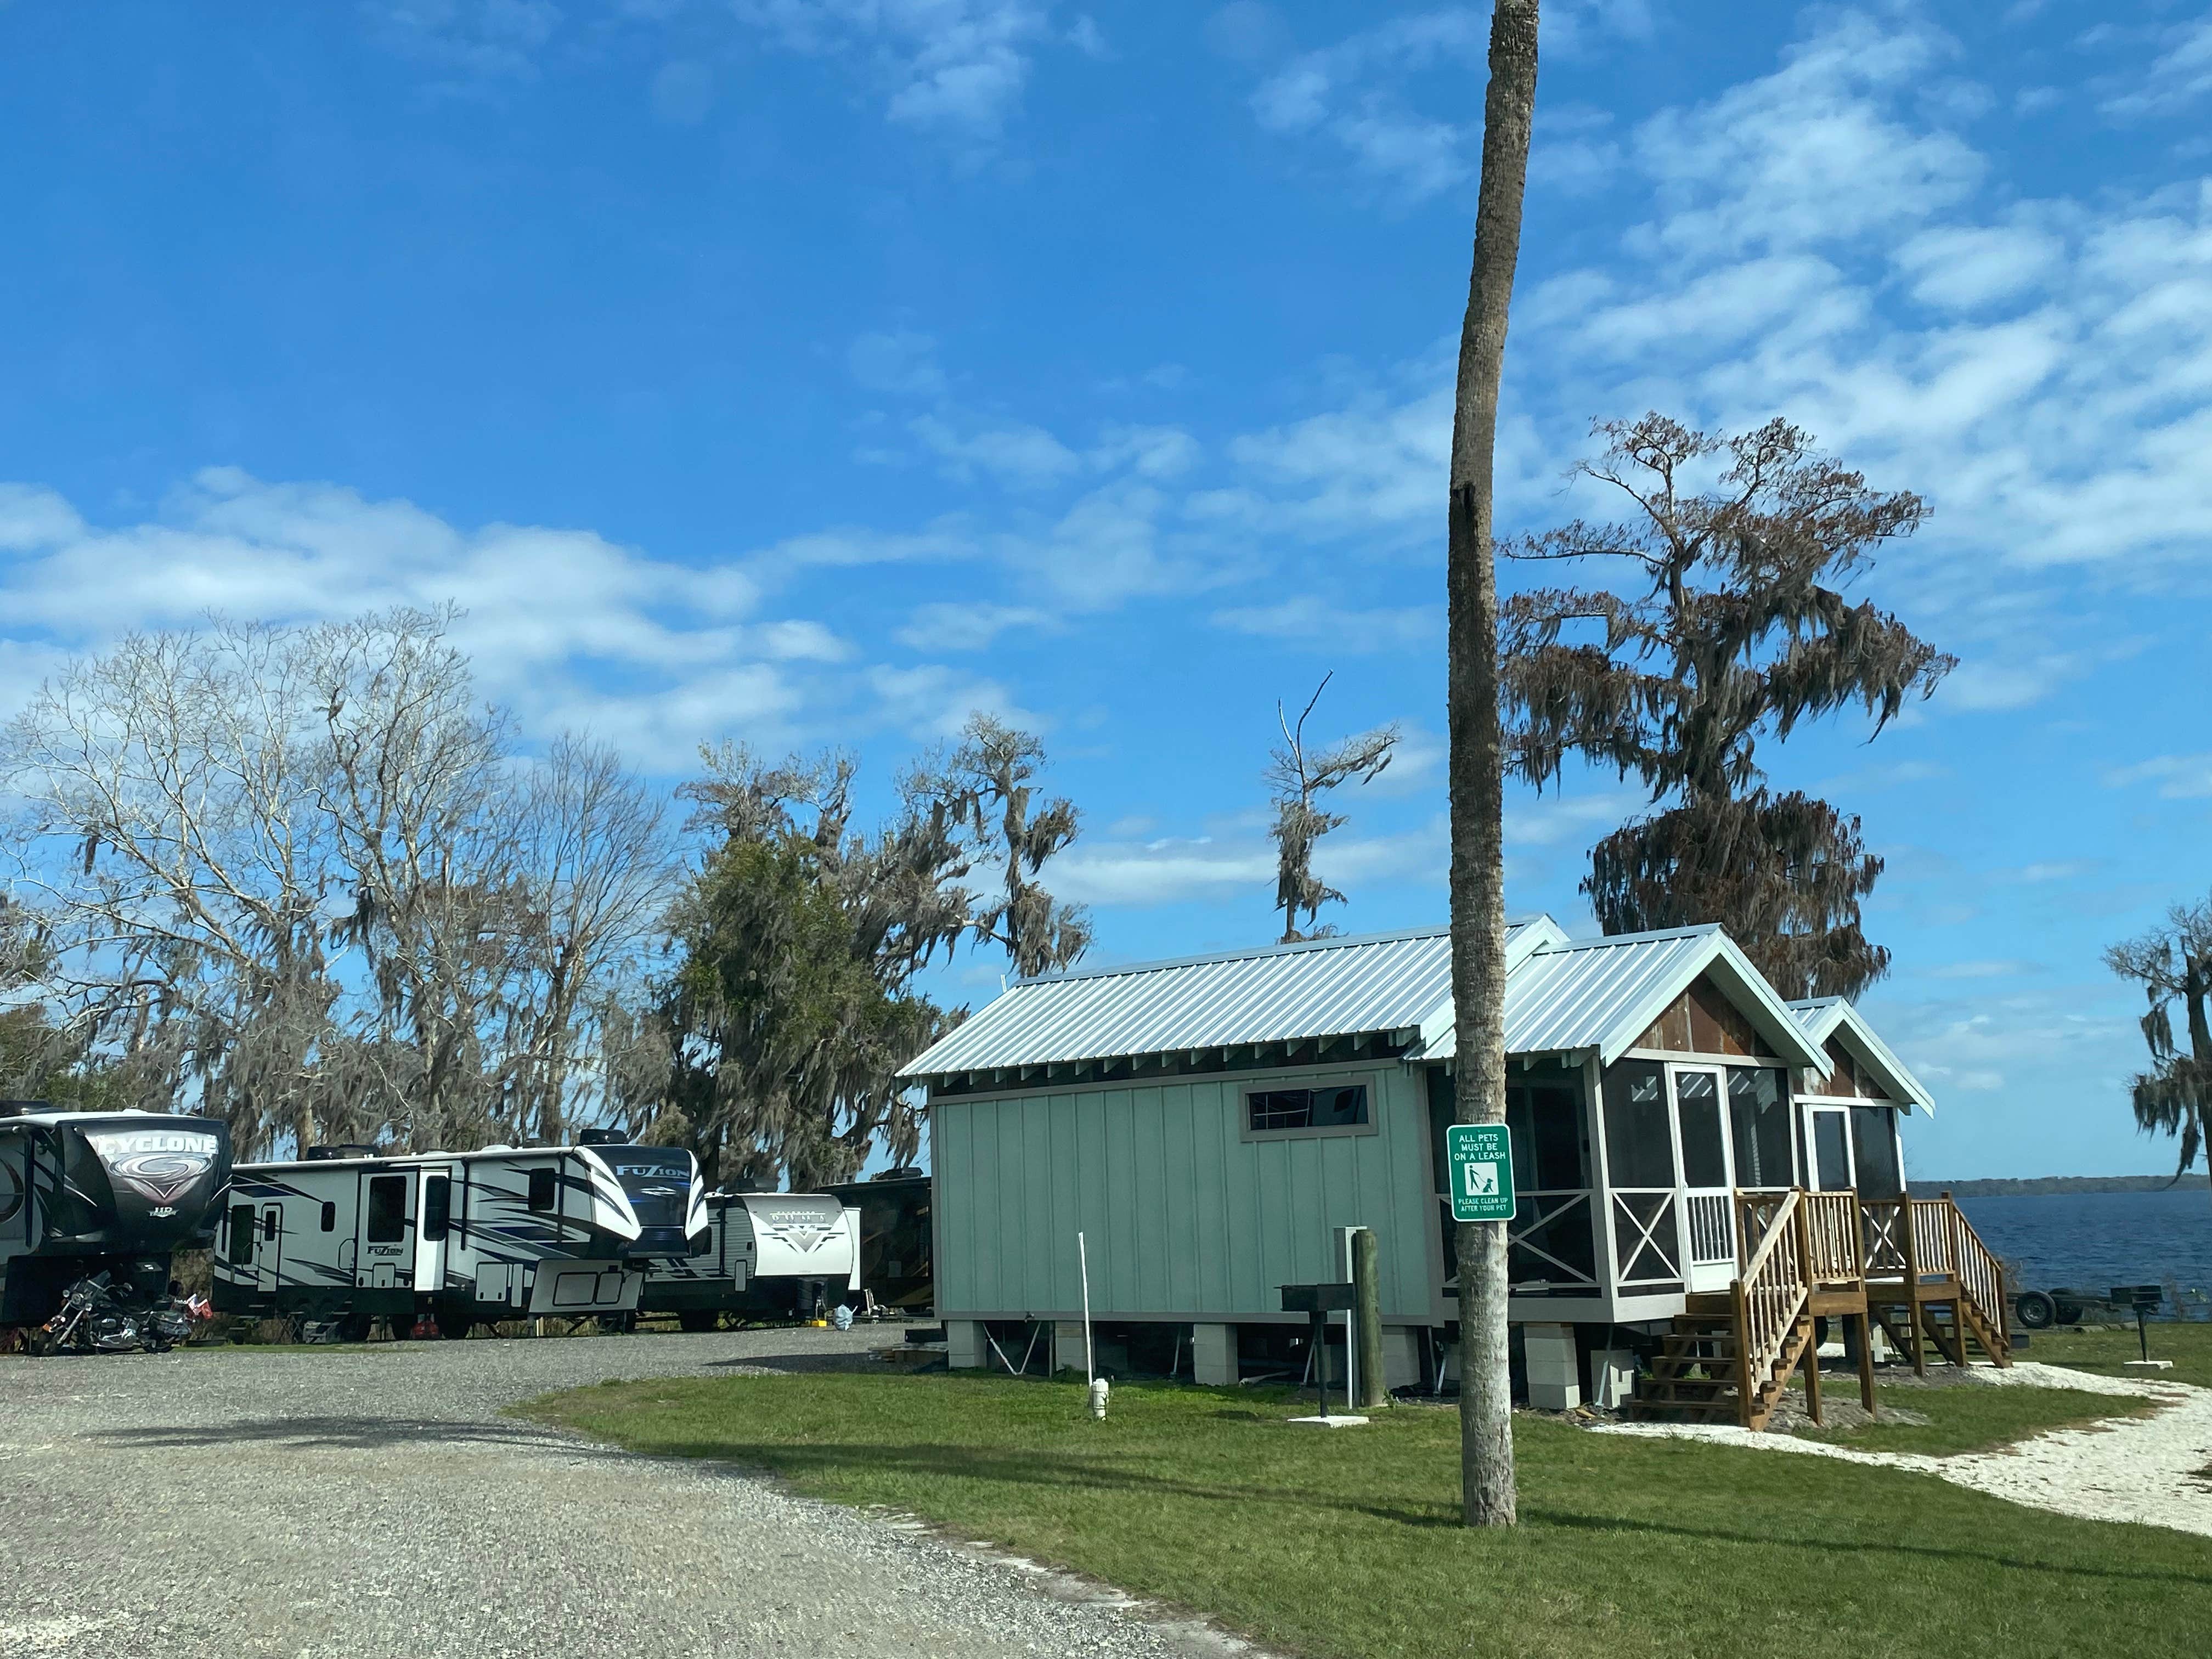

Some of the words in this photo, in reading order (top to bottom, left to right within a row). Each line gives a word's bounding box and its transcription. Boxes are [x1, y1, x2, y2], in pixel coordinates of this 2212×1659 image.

[98, 1136, 218, 1154] CYCLONE
[616, 1165, 690, 1179] FUZION
[367, 1246, 404, 1256] FUZION
